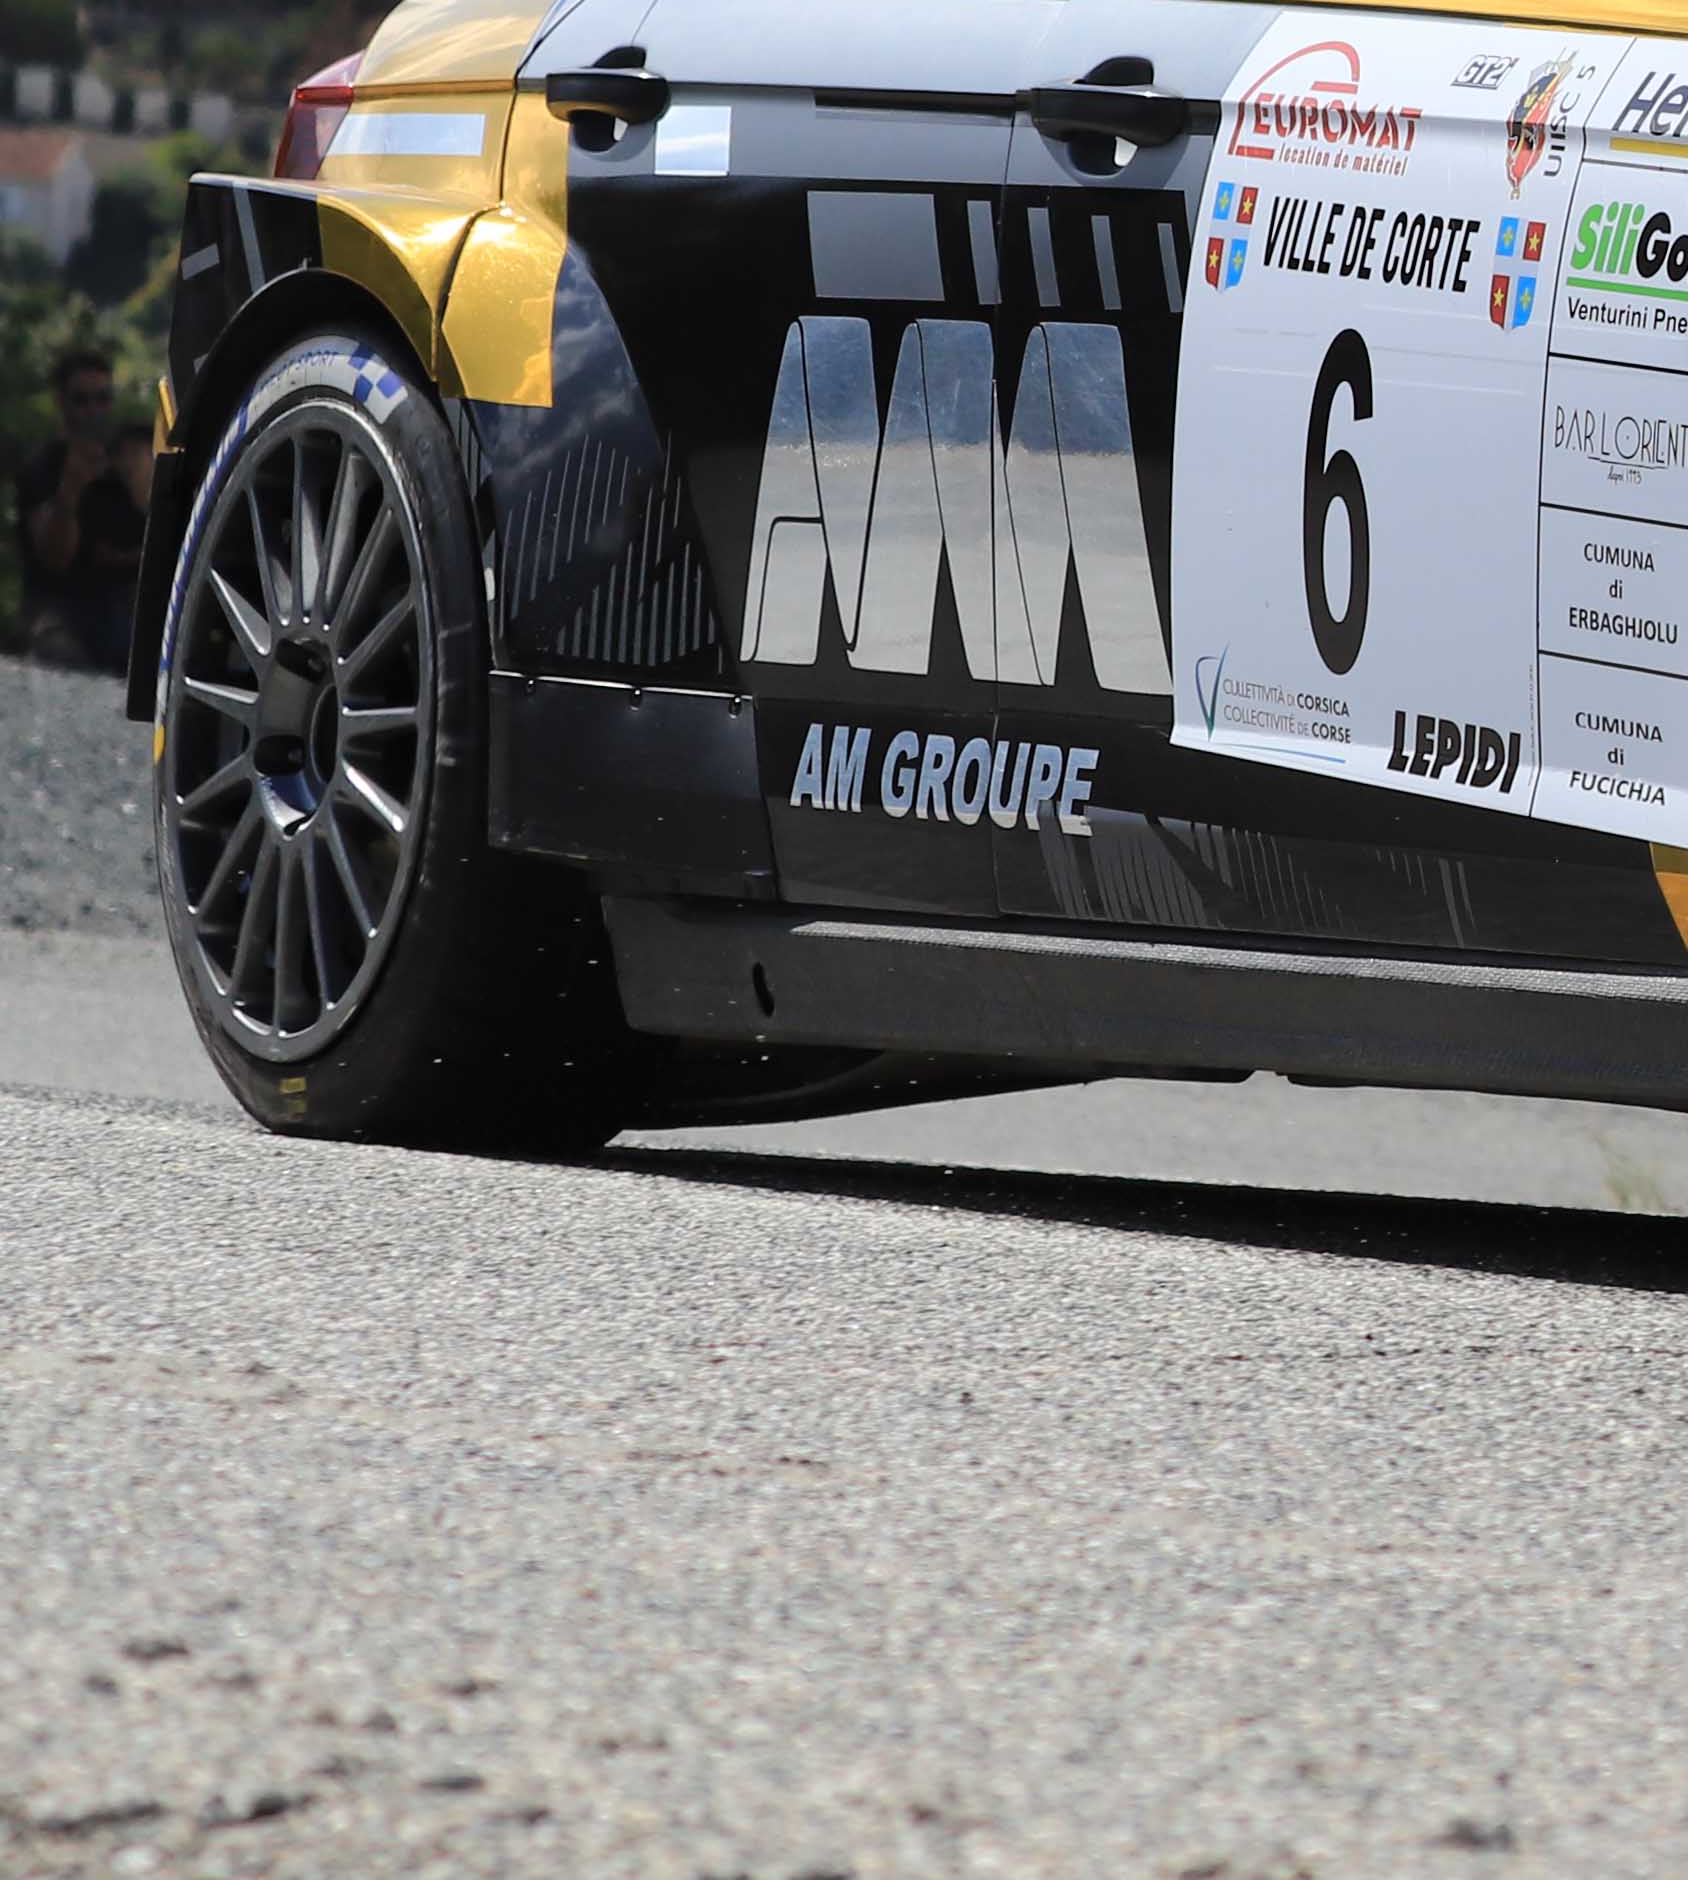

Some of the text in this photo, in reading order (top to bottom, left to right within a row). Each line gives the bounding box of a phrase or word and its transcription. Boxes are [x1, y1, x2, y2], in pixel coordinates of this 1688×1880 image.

[1253, 93, 1423, 151] EUROMAT
[1279, 143, 1409, 176] location de matériel
[1264, 196, 1481, 293] VILLE DE CORTE
[1567, 296, 1648, 329] Venturini
[1554, 405, 1596, 454] BAR
[1303, 328, 1374, 676] 6
[1584, 542, 1655, 572] CUMUNA
[1608, 579, 1623, 599] di
[1569, 606, 1678, 645] ERBAGHJOLU
[1296, 692, 1351, 718] CORSICA
[1223, 704, 1352, 744] COLLECTIVITÉ DE CORSE
[1575, 711, 1663, 743] CUMUNA
[1387, 710, 1522, 794] LEPIDI
[1607, 747, 1624, 766] di
[790, 723, 1100, 837] AM GROUPE
[1569, 770, 1666, 806] FUCICHJA
